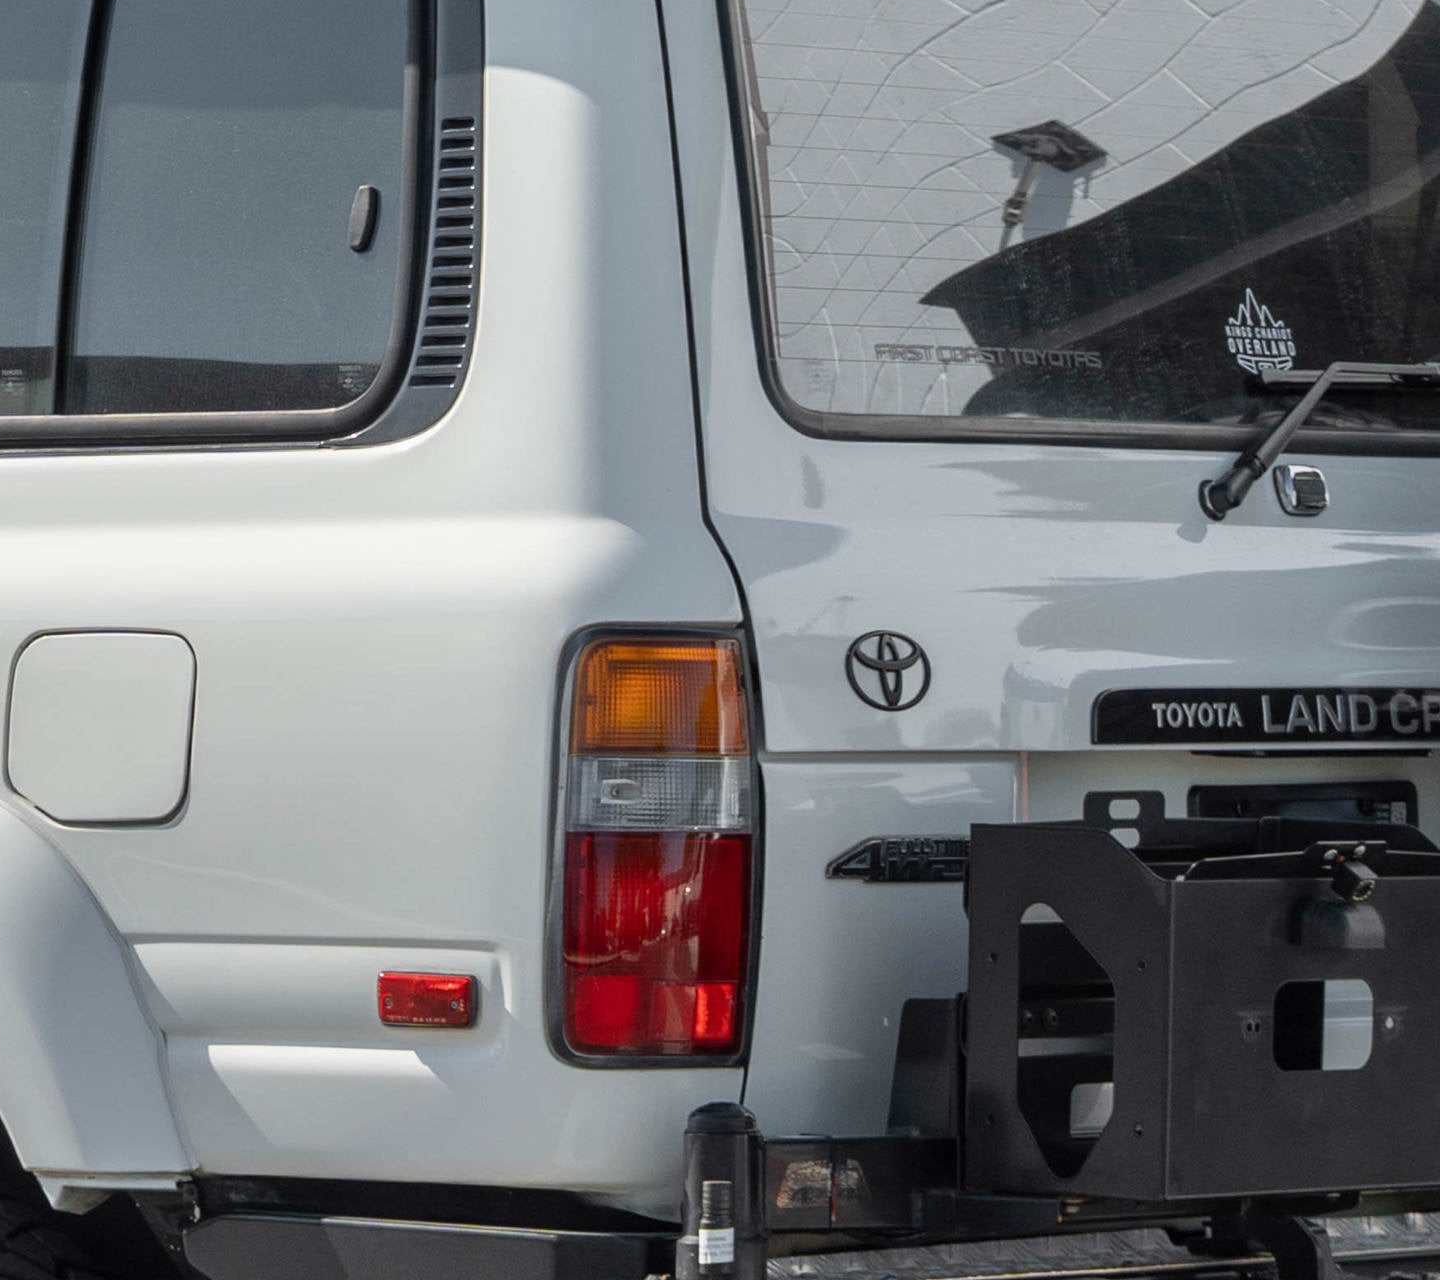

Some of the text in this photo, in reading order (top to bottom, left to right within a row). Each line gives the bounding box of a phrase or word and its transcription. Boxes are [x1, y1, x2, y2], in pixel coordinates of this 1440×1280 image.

[1225, 325, 1293, 340] KINGS CHARIOT
[874, 343, 1103, 369] FIRST COAST TOYOTAS
[1227, 338, 1296, 357] OVERLAND
[1152, 702, 1244, 729] TOYOTA
[1261, 693, 1379, 735] LAND
